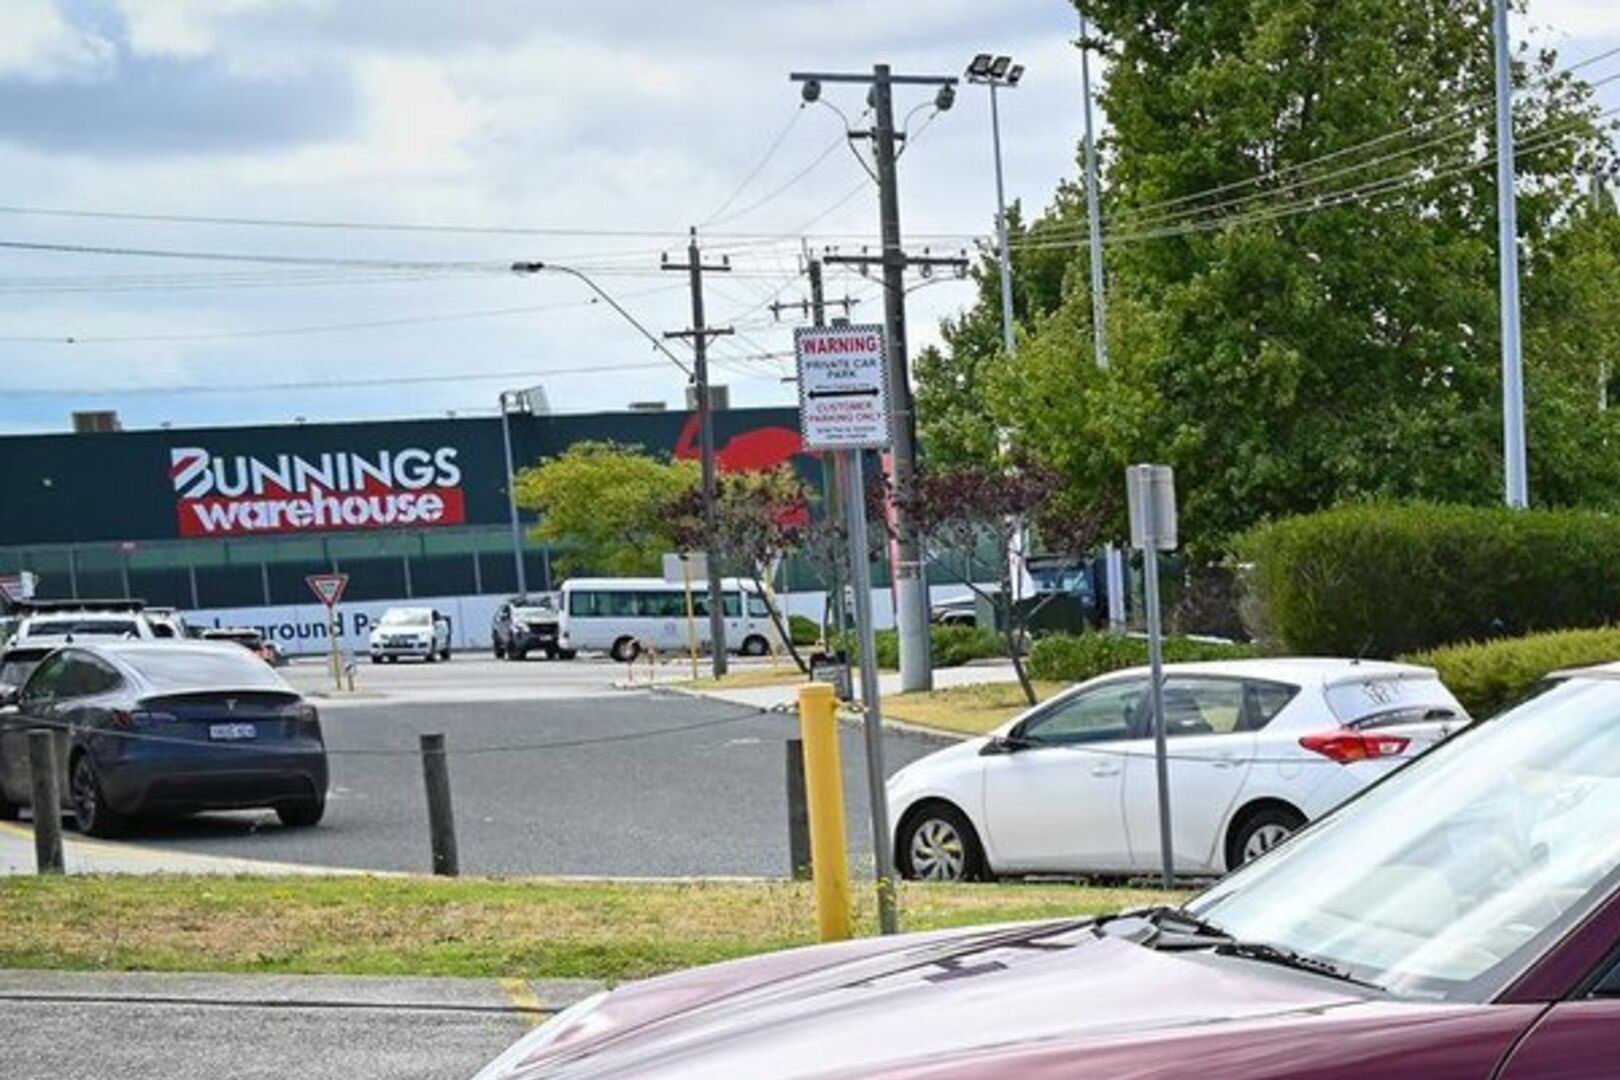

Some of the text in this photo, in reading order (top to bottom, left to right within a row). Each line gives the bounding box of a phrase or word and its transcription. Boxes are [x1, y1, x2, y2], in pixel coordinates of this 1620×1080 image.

[802, 336, 877, 354] WARNING
[853, 358, 877, 368] CAR
[816, 402, 872, 413] CUSTOMER
[171, 447, 461, 498] BUNNINGS
[192, 484, 444, 532] warehouse
